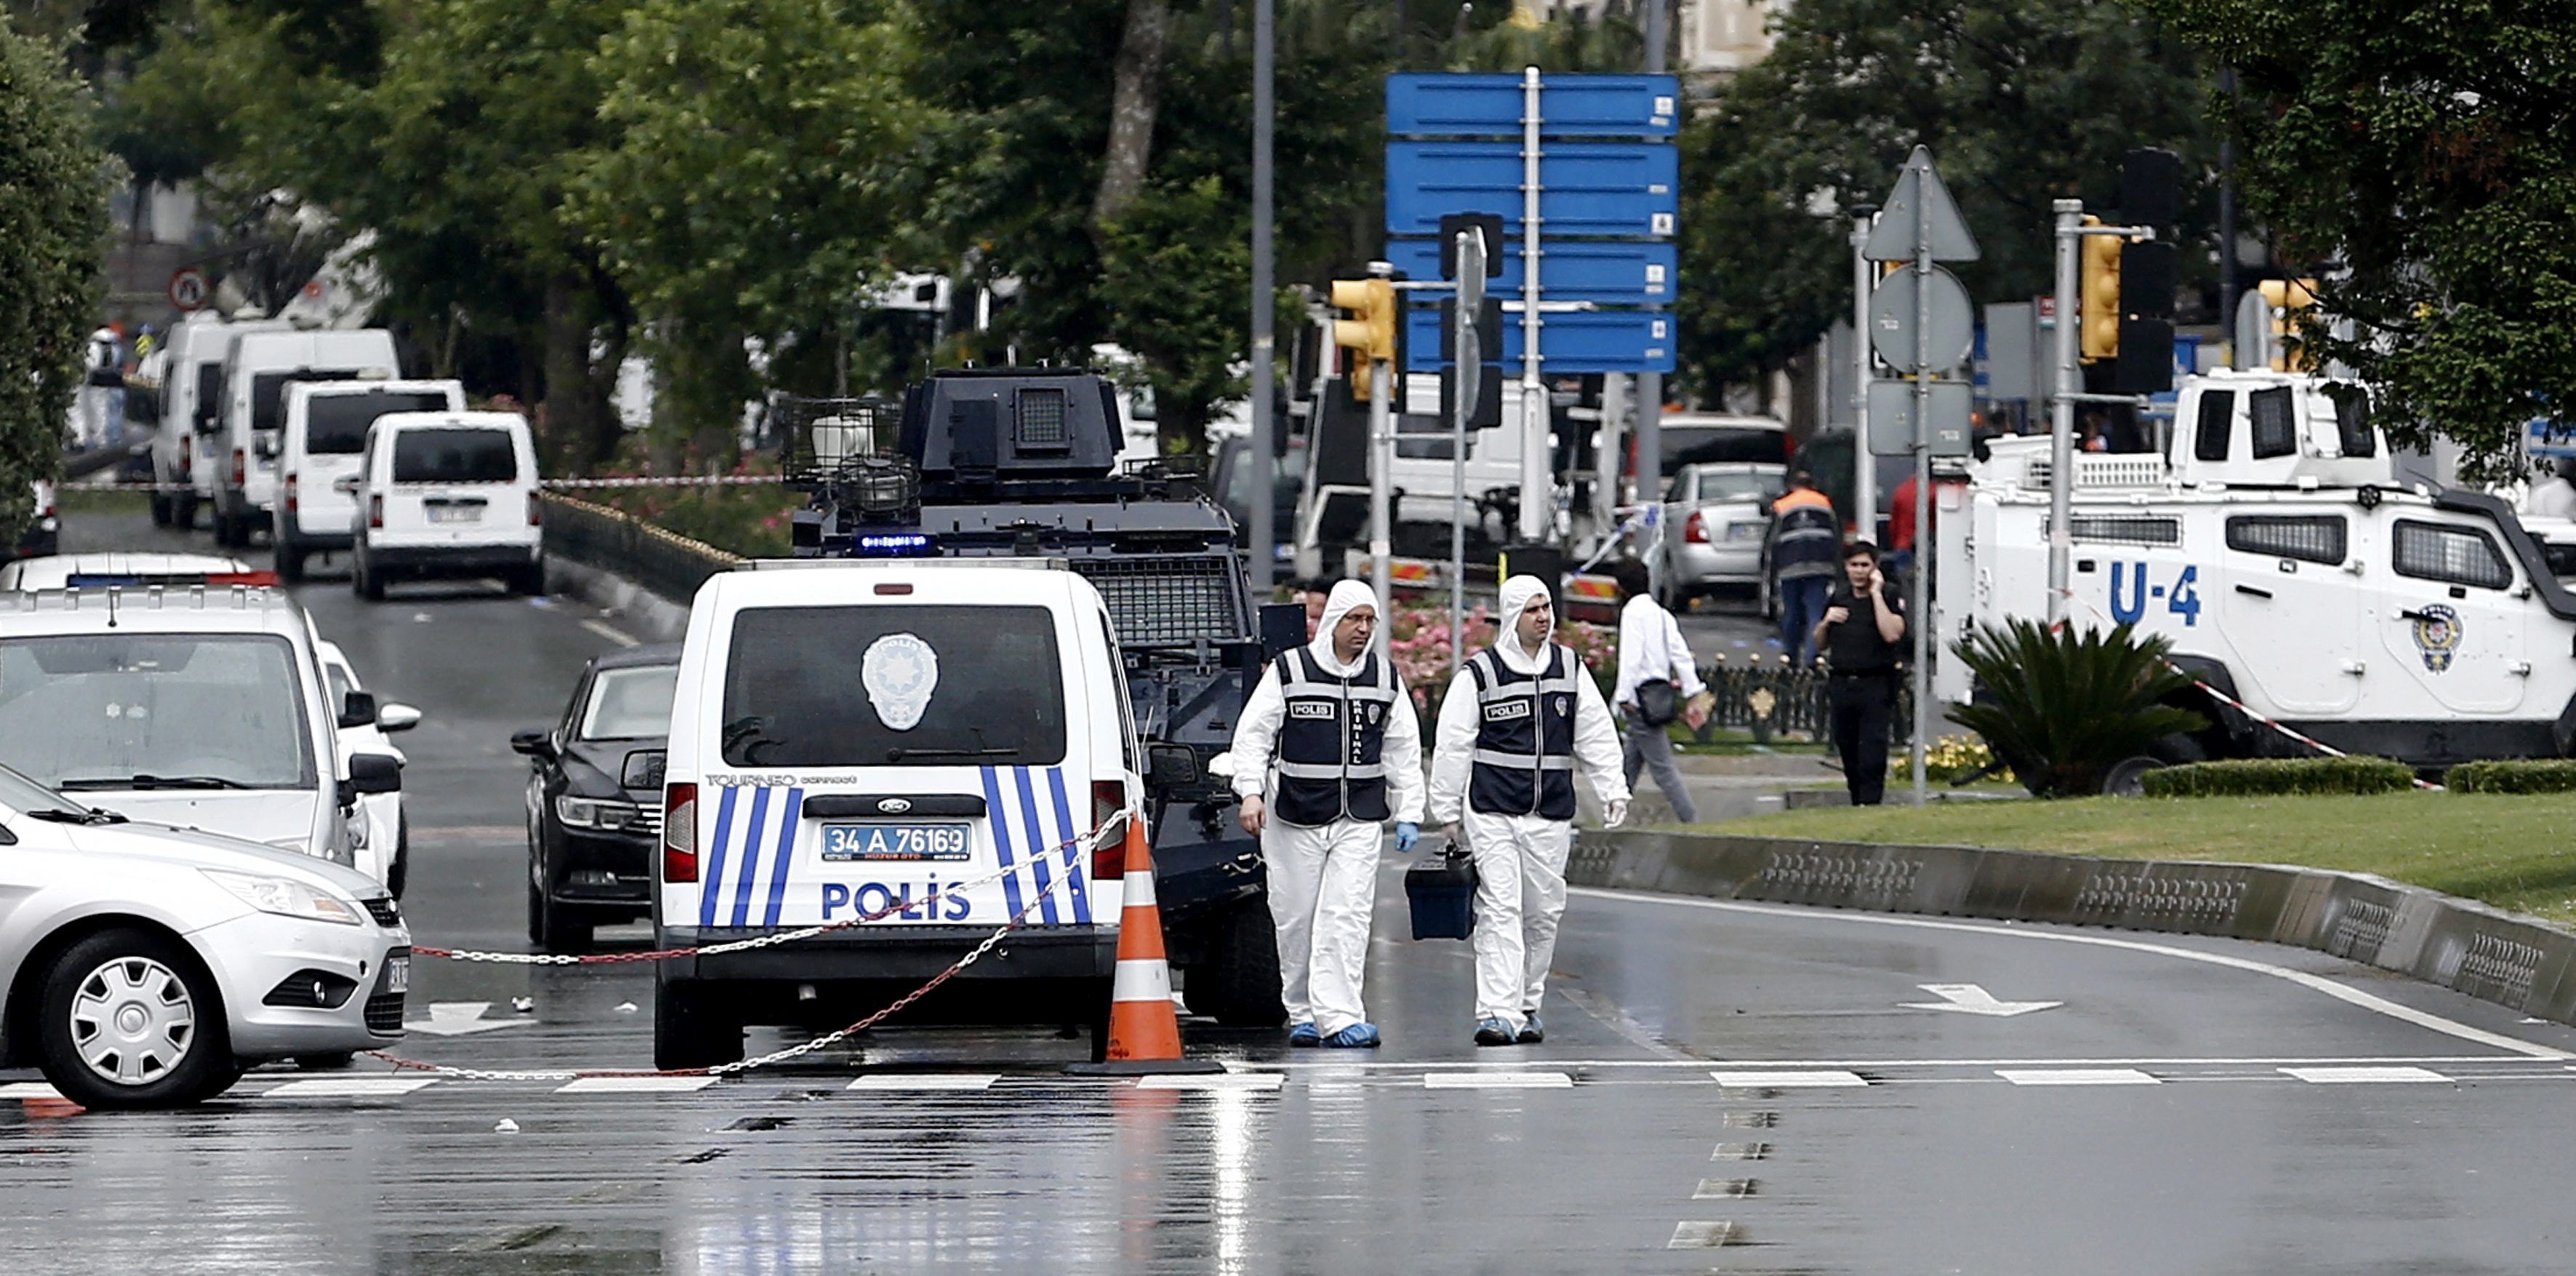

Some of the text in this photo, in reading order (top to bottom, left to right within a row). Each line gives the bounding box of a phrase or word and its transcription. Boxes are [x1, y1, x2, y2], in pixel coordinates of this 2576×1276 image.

[2111, 562, 2200, 626] U-4
[1352, 699, 1363, 763] KRIMINAL
[705, 774, 797, 787] TOURNEO
[831, 829, 963, 852] 34 A 76169
